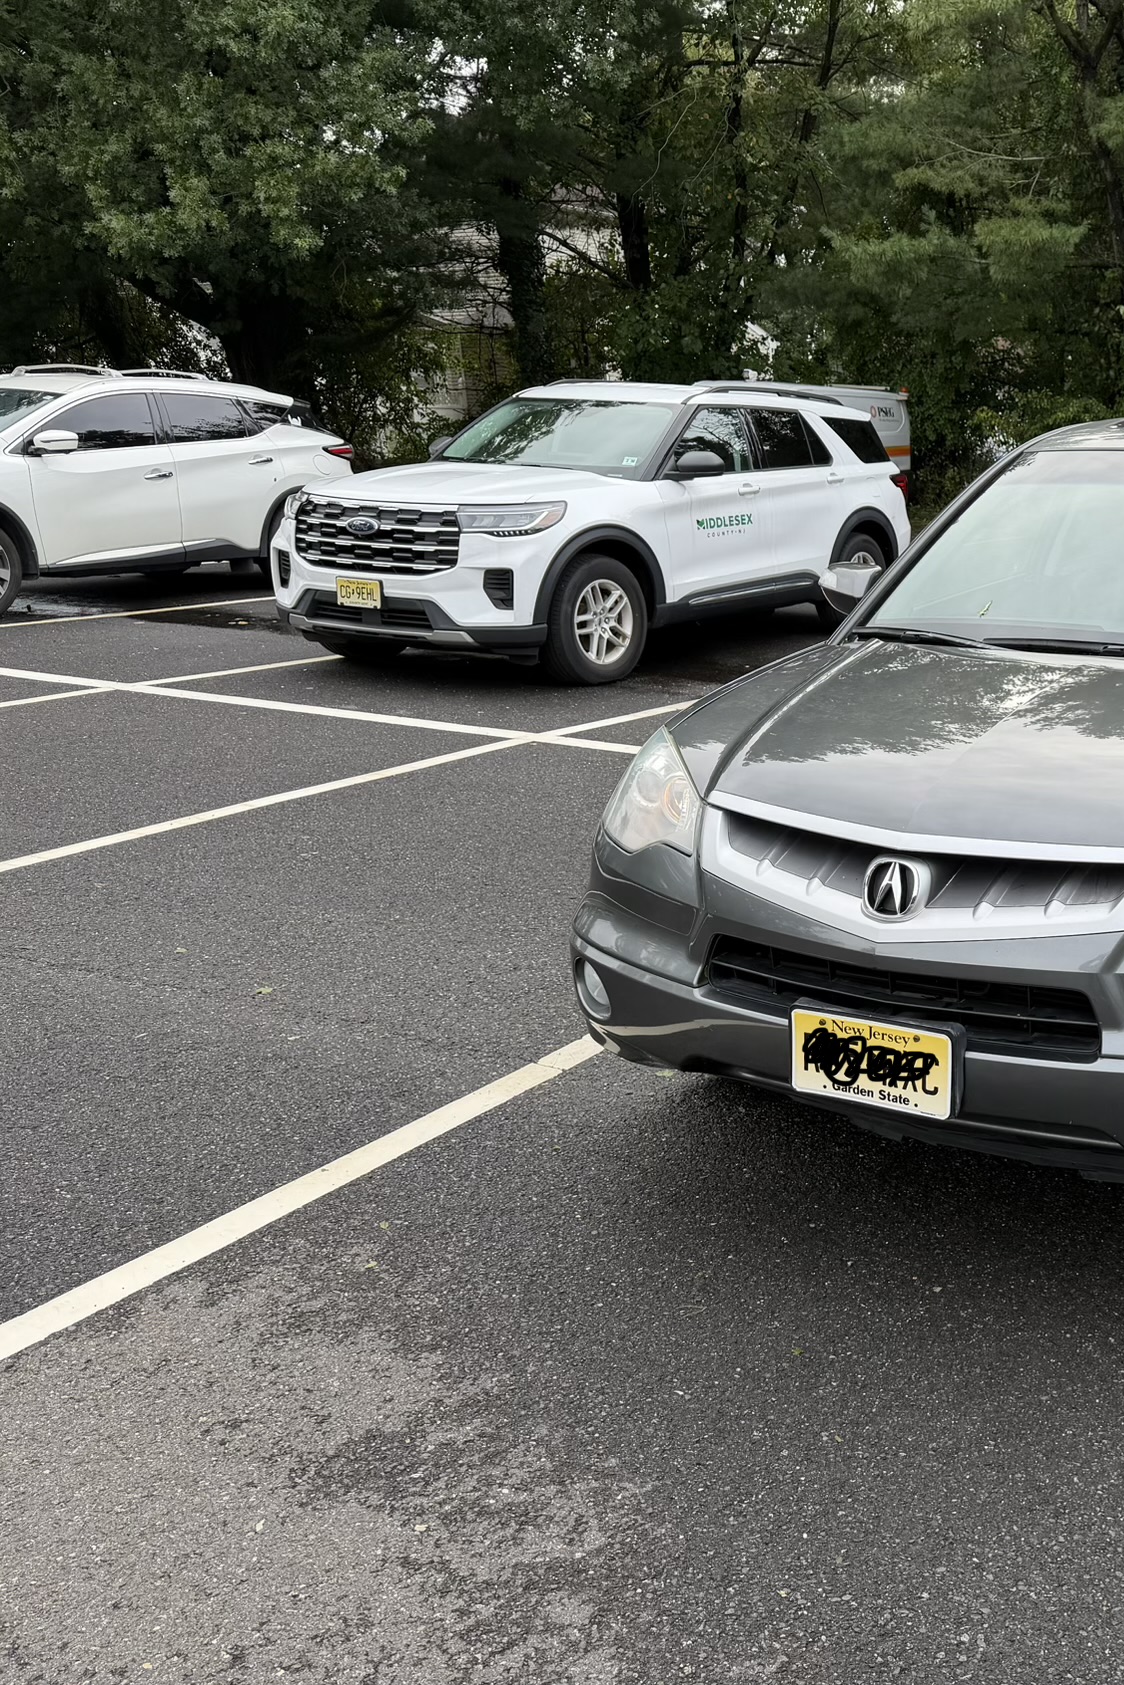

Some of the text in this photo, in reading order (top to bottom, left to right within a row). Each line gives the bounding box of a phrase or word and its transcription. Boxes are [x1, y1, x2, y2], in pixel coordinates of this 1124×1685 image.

[696, 513, 753, 530] MIDDLESEX
[831, 1019, 911, 1048] New Jersey
[832, 1082, 910, 1106] Garden State
